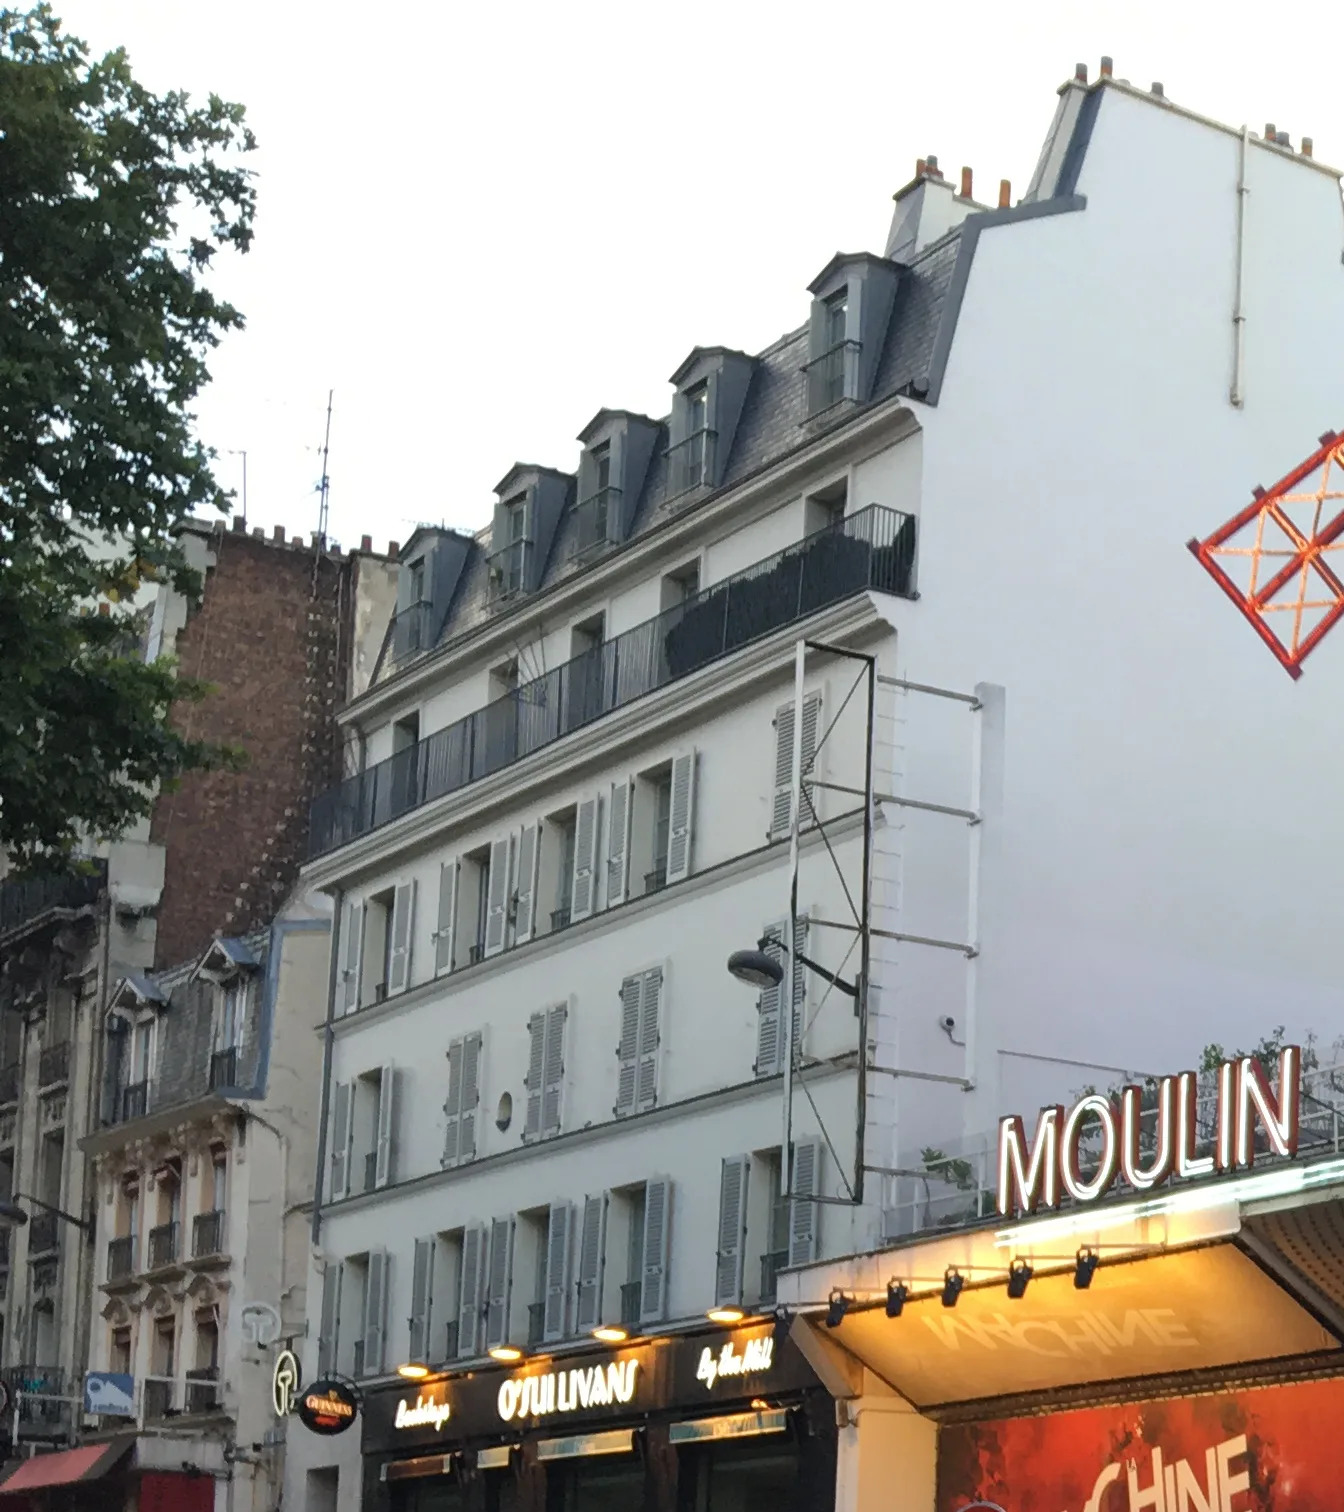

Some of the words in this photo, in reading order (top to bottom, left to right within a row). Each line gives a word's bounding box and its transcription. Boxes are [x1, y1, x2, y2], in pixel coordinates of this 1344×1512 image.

[998, 1044, 1301, 1217] MOULIN
[717, 1341, 742, 1377] the
[306, 1394, 353, 1417] GUINNESS
